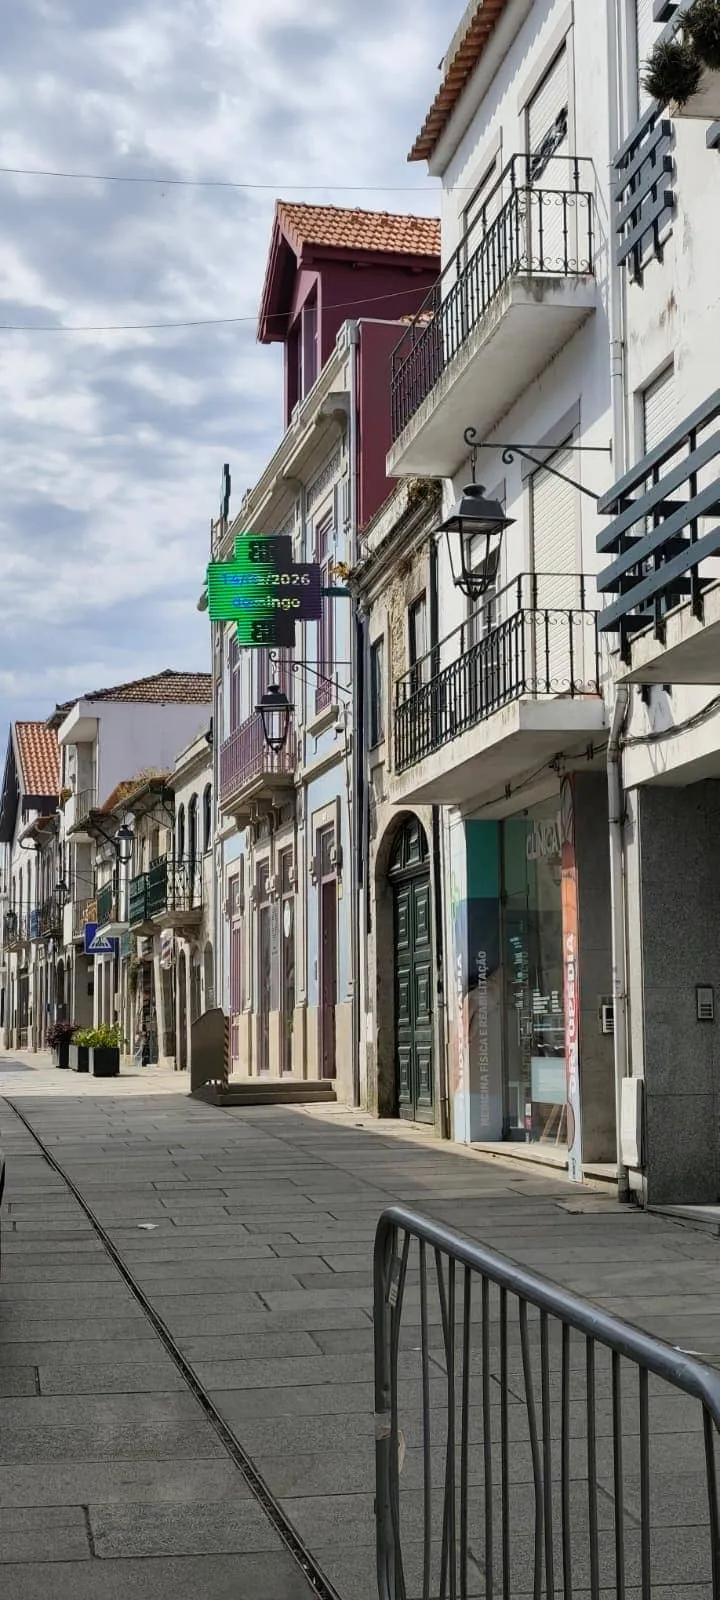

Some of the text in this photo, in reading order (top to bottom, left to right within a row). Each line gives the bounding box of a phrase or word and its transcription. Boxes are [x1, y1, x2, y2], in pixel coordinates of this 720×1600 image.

[476, 951, 488, 1026] REABILITAÇÃO
[566, 933, 576, 1098] ORTOPEDIA
[478, 1038, 489, 1072] FÍSICA
[480, 1075, 490, 1127] MEDICINA
